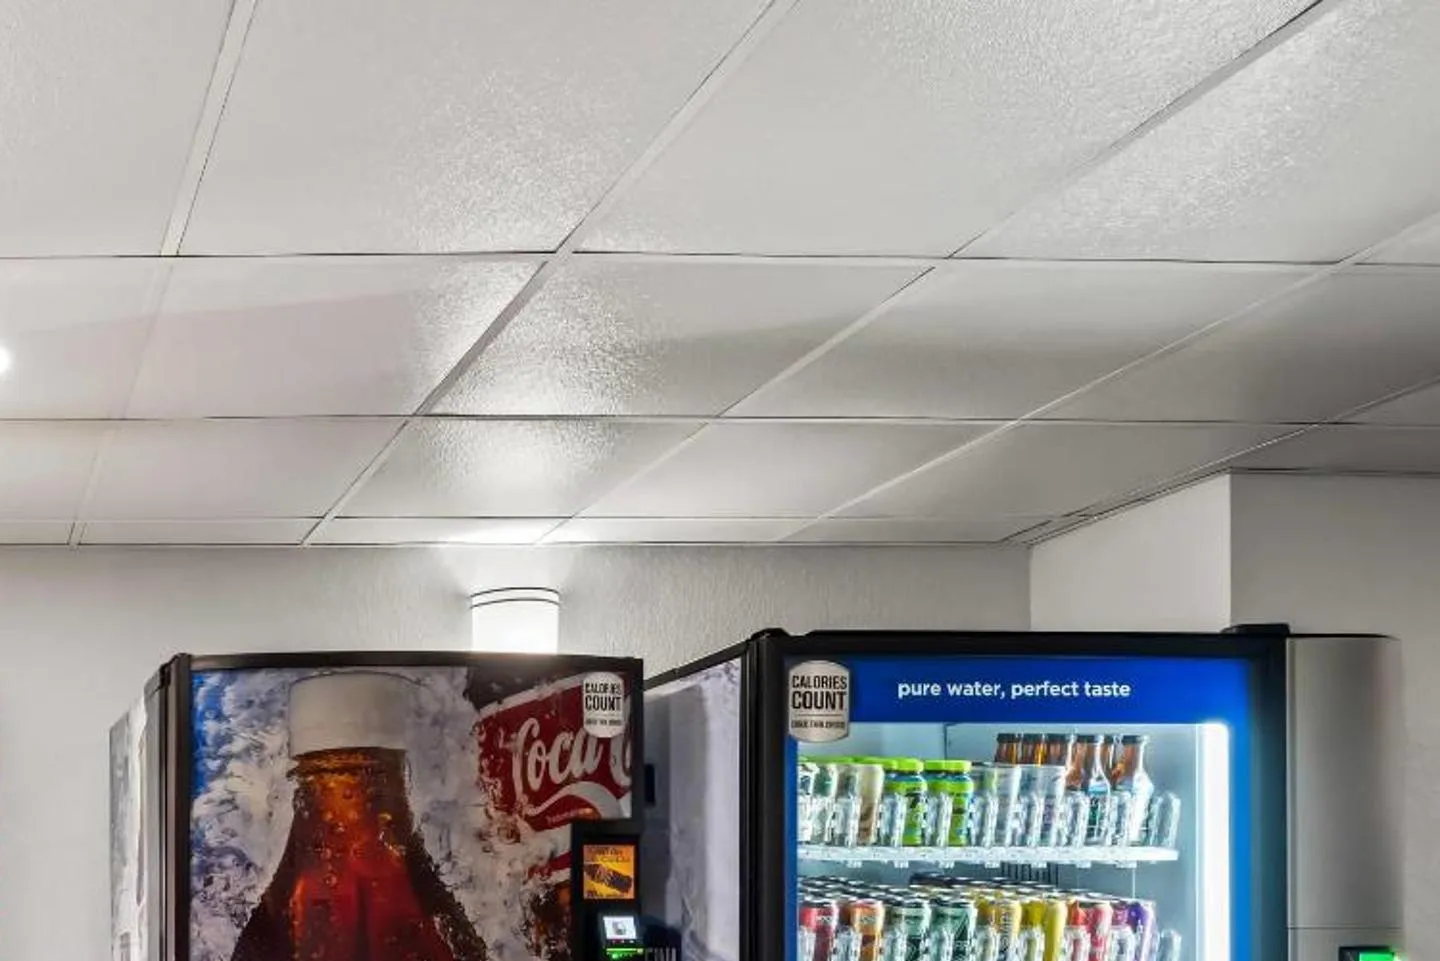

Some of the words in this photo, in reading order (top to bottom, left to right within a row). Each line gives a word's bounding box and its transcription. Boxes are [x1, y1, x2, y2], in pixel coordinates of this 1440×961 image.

[792, 675, 848, 690] CALORIES
[898, 682, 942, 699] pure
[946, 682, 1005, 699] water,
[1011, 681, 1079, 699] perfect
[1084, 681, 1131, 697] taste
[585, 695, 622, 711] COUNT
[792, 690, 848, 711] COUNT
